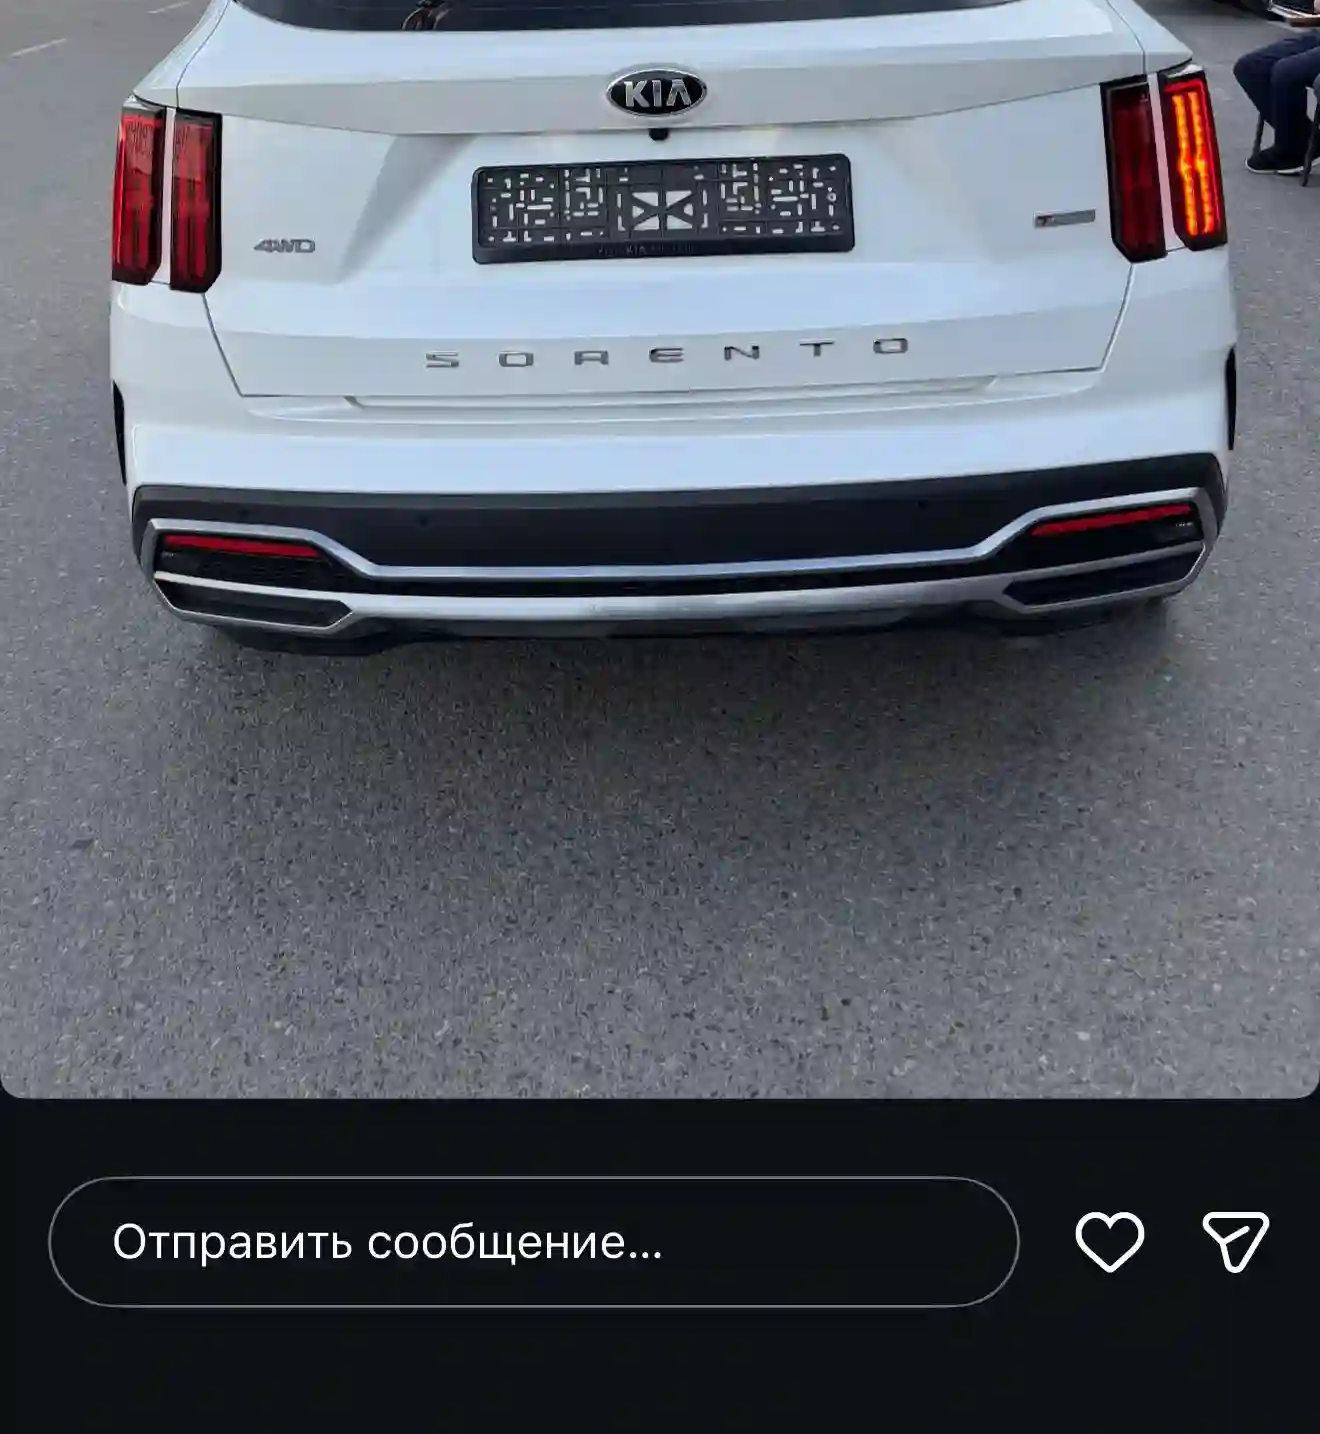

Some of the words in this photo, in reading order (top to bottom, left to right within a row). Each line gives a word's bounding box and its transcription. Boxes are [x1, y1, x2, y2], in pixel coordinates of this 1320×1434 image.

[623, 79, 692, 108] KIA
[253, 238, 316, 253] 4WD
[425, 337, 909, 368] SORENTO
